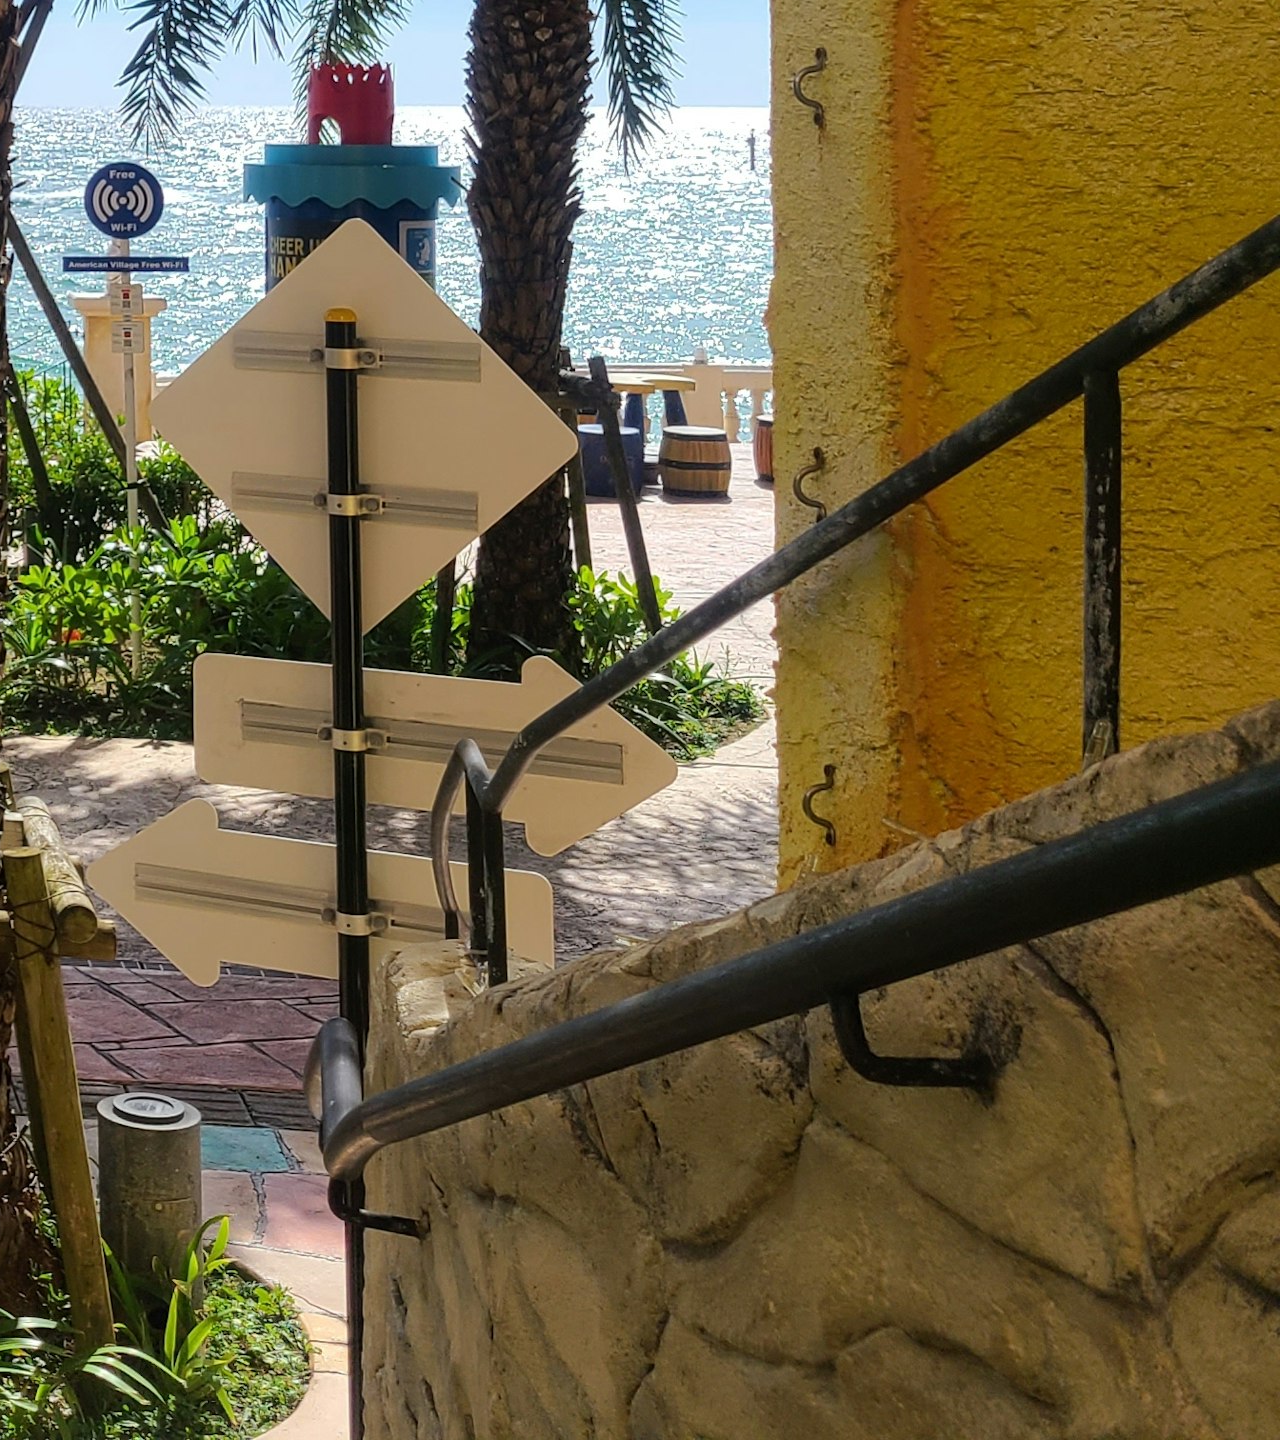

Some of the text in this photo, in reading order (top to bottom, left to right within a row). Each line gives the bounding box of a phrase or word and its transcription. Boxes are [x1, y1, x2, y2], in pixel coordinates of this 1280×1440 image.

[109, 169, 136, 179] Free
[110, 223, 137, 232] Wi-Fi
[68, 261, 184, 270] American Village Free Wi-Fi
[270, 256, 305, 278] HAN
